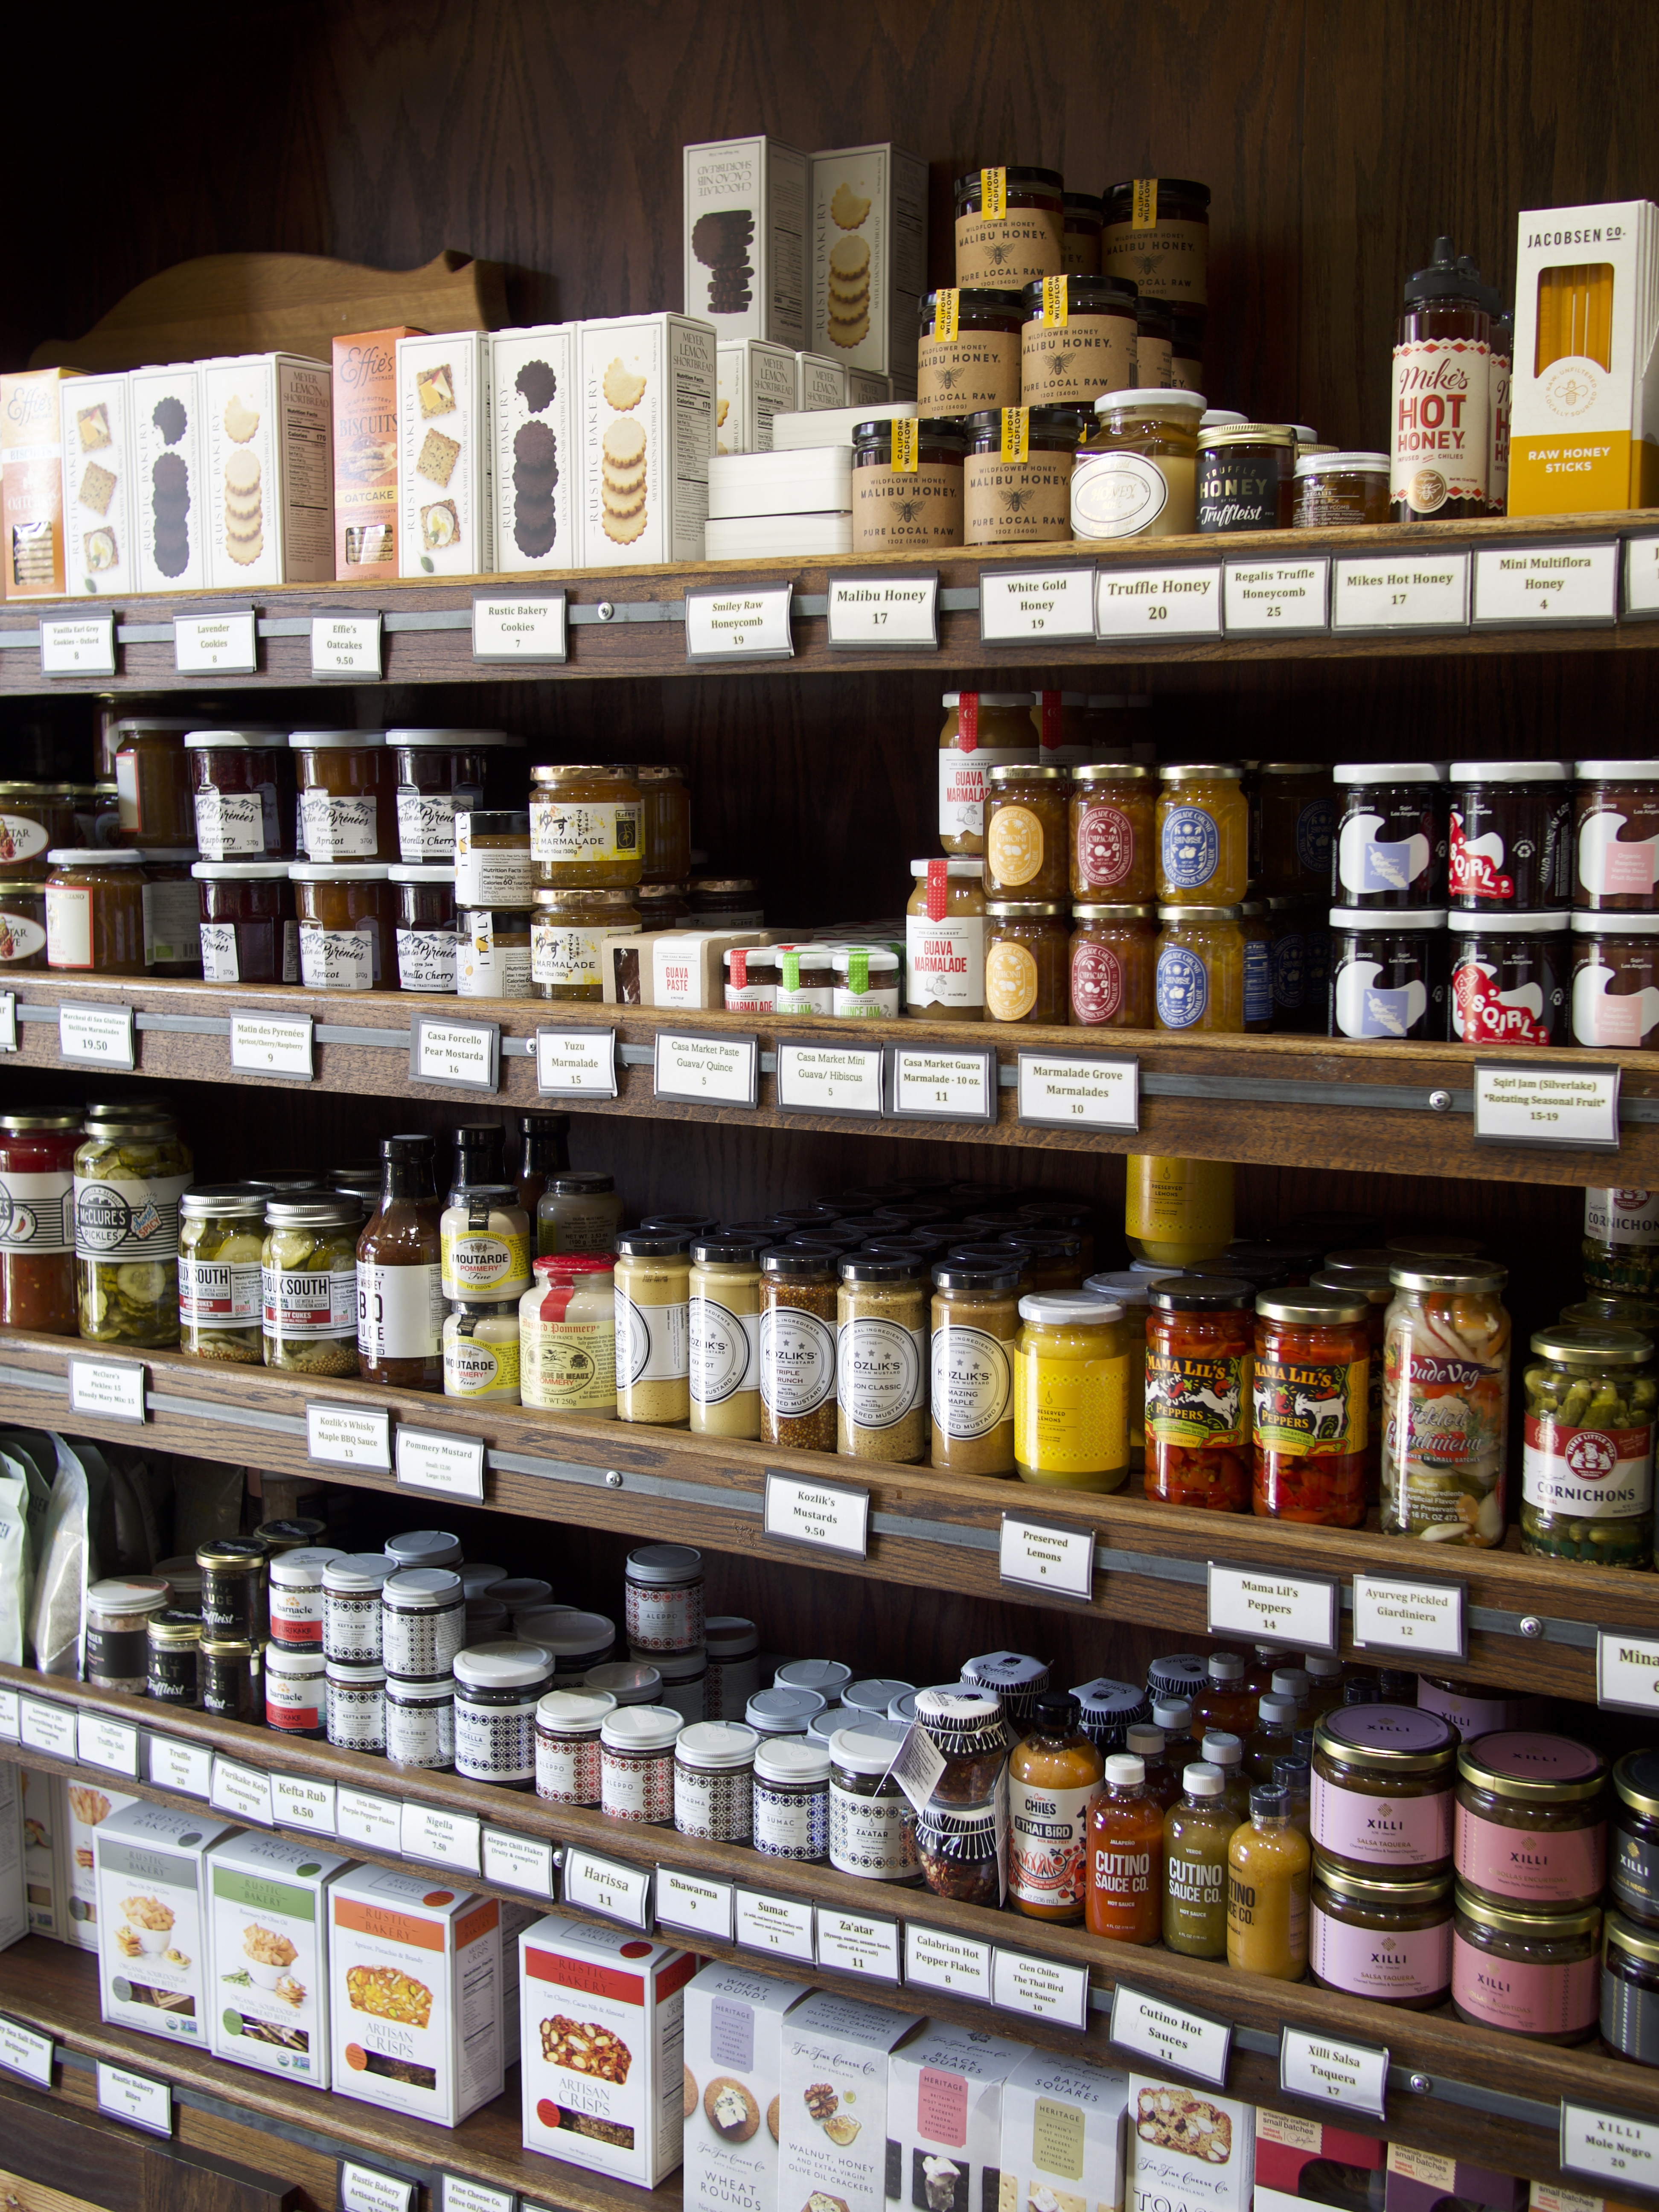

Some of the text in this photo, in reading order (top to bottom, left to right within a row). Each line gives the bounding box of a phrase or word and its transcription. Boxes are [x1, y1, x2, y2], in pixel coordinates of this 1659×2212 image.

[1528, 227, 1626, 248] JACOBSEN CO.
[683, 332, 704, 346] MEYER
[678, 341, 707, 363] LEMON
[340, 346, 394, 388] Effie's
[673, 353, 713, 375] SHORTBREAD
[1400, 359, 1470, 396] Mike's
[1398, 394, 1466, 431] HOT
[1398, 431, 1465, 452] HONEY
[1528, 447, 1610, 461] RAW HONEY
[1206, 466, 1257, 477] TRUFFLE
[1545, 462, 1592, 473] STICKS
[861, 487, 905, 499] MALIBU
[1200, 478, 1268, 499] HONEY
[345, 490, 394, 503] OATCAKE
[1200, 506, 1262, 526] Truffleist
[864, 528, 886, 537] PURE
[934, 527, 954, 536] RAW
[1499, 557, 1591, 570] Mini Multiflora
[1347, 572, 1453, 587] Mikes Hot Honey
[1525, 579, 1564, 591] Honey
[1108, 580, 1211, 596] Truffle Honey
[837, 590, 926, 603] Malibu Honey
[1392, 594, 1406, 605] 17
[489, 606, 548, 616] Rustic Bakery
[713, 601, 763, 612] Smiley Raw
[1540, 599, 1548, 609] 4
[873, 613, 888, 624] 17
[1149, 607, 1167, 620] 20
[333, 625, 357, 633] Effie's
[501, 623, 534, 632] Cookies
[712, 617, 763, 630] Honeycomb
[327, 640, 362, 649] Oatcakes
[515, 640, 520, 648] 7
[733, 636, 744, 644] 19
[336, 656, 353, 665] 9.50
[315, 836, 345, 846] Apricot
[924, 940, 953, 956] GUAVA
[914, 956, 967, 972] MARMALADE
[666, 967, 689, 979] GUAVA
[667, 979, 688, 991] PASTE
[1471, 994, 1534, 1037] SQIRL
[428, 1032, 481, 1045] Casa Forcello
[565, 1042, 585, 1051] Yuzu
[425, 1047, 483, 1061] Pear Mostarda
[552, 1058, 598, 1068] Marmalade
[571, 1075, 581, 1084] 15
[1033, 1067, 1123, 1080] Marmalade Grove
[1047, 1085, 1109, 1097] Marmalades
[1493, 1078, 1597, 1092] Sqirl Jam (Silverlake)
[1072, 1104, 1084, 1114] 10
[1530, 1112, 1559, 1121] 15-19
[80, 1208, 127, 1226] McCLURE'S
[85, 1229, 118, 1241] PICKLES
[452, 1252, 508, 1266] MOUTARDE
[469, 1272, 491, 1281] Fine
[264, 1277, 327, 1295] DOUX SOUTH
[1147, 1355, 1226, 1380] MAMA LIL'S
[1156, 1403, 1203, 1420] PEPPERS
[320, 1417, 375, 1433] Kozlik's Whisky
[318, 1431, 377, 1447] Maple BBQ Sauce
[1537, 1481, 1635, 1501] CORNICHONS
[798, 1491, 835, 1506] Kozlik's
[794, 1507, 837, 1523] Mustards
[805, 1525, 824, 1537] 9.50
[1023, 1531, 1068, 1547] Preserved
[1027, 1547, 1061, 1562] Lemons
[1242, 1580, 1298, 1598] Mama Lil's
[1365, 1588, 1448, 1607] Ayurveg Pickled
[277, 1602, 313, 1615] barnacle
[1248, 1599, 1291, 1615] Peppers
[1377, 1607, 1436, 1622] Giardiniera
[1263, 1620, 1276, 1629] 14
[1401, 1626, 1413, 1635] 12
[279, 1783, 326, 1802] Kefta Rub
[293, 1805, 314, 1818] 8.50
[766, 1816, 795, 1826] SUMAC
[1367, 1819, 1403, 1831] XILLI
[856, 1828, 888, 1838] ZA'ATAR
[1356, 1837, 1411, 1848] SALSA TAQUERA
[1095, 1850, 1150, 1876] CUTINO
[584, 1863, 631, 1891] Harissa
[1094, 1874, 1149, 1893] SAUCE CO.
[599, 1894, 612, 1906] 11
[758, 1902, 788, 1917] Sumac
[840, 1920, 874, 1936] Za'atar
[770, 1935, 778, 1943] 11
[917, 1933, 979, 1959] Calabrian Hot
[558, 1959, 608, 1981] RUSTIC
[853, 1958, 864, 1968] 11
[917, 1951, 980, 1976] Pepper Flakes
[558, 1972, 608, 1994] BAKERY
[946, 1975, 951, 1983] 8
[716, 2005, 751, 2019] HERITAGE
[1140, 2002, 1202, 2036] Cutino Hot
[1149, 2024, 1190, 2049] Sauces
[1157, 2049, 1173, 2062] 11
[1308, 2045, 1360, 2068] Xilli Salsa
[1310, 2064, 1356, 2086] Taquera
[559, 2078, 610, 2101] ARTISAN
[1327, 2086, 1340, 2096] 17
[559, 2090, 610, 2116] CRISPS
[1263, 2116, 1314, 2136] small batches
[704, 2170, 757, 2196] WHEAT
[700, 2183, 762, 2211] ROUNDS
